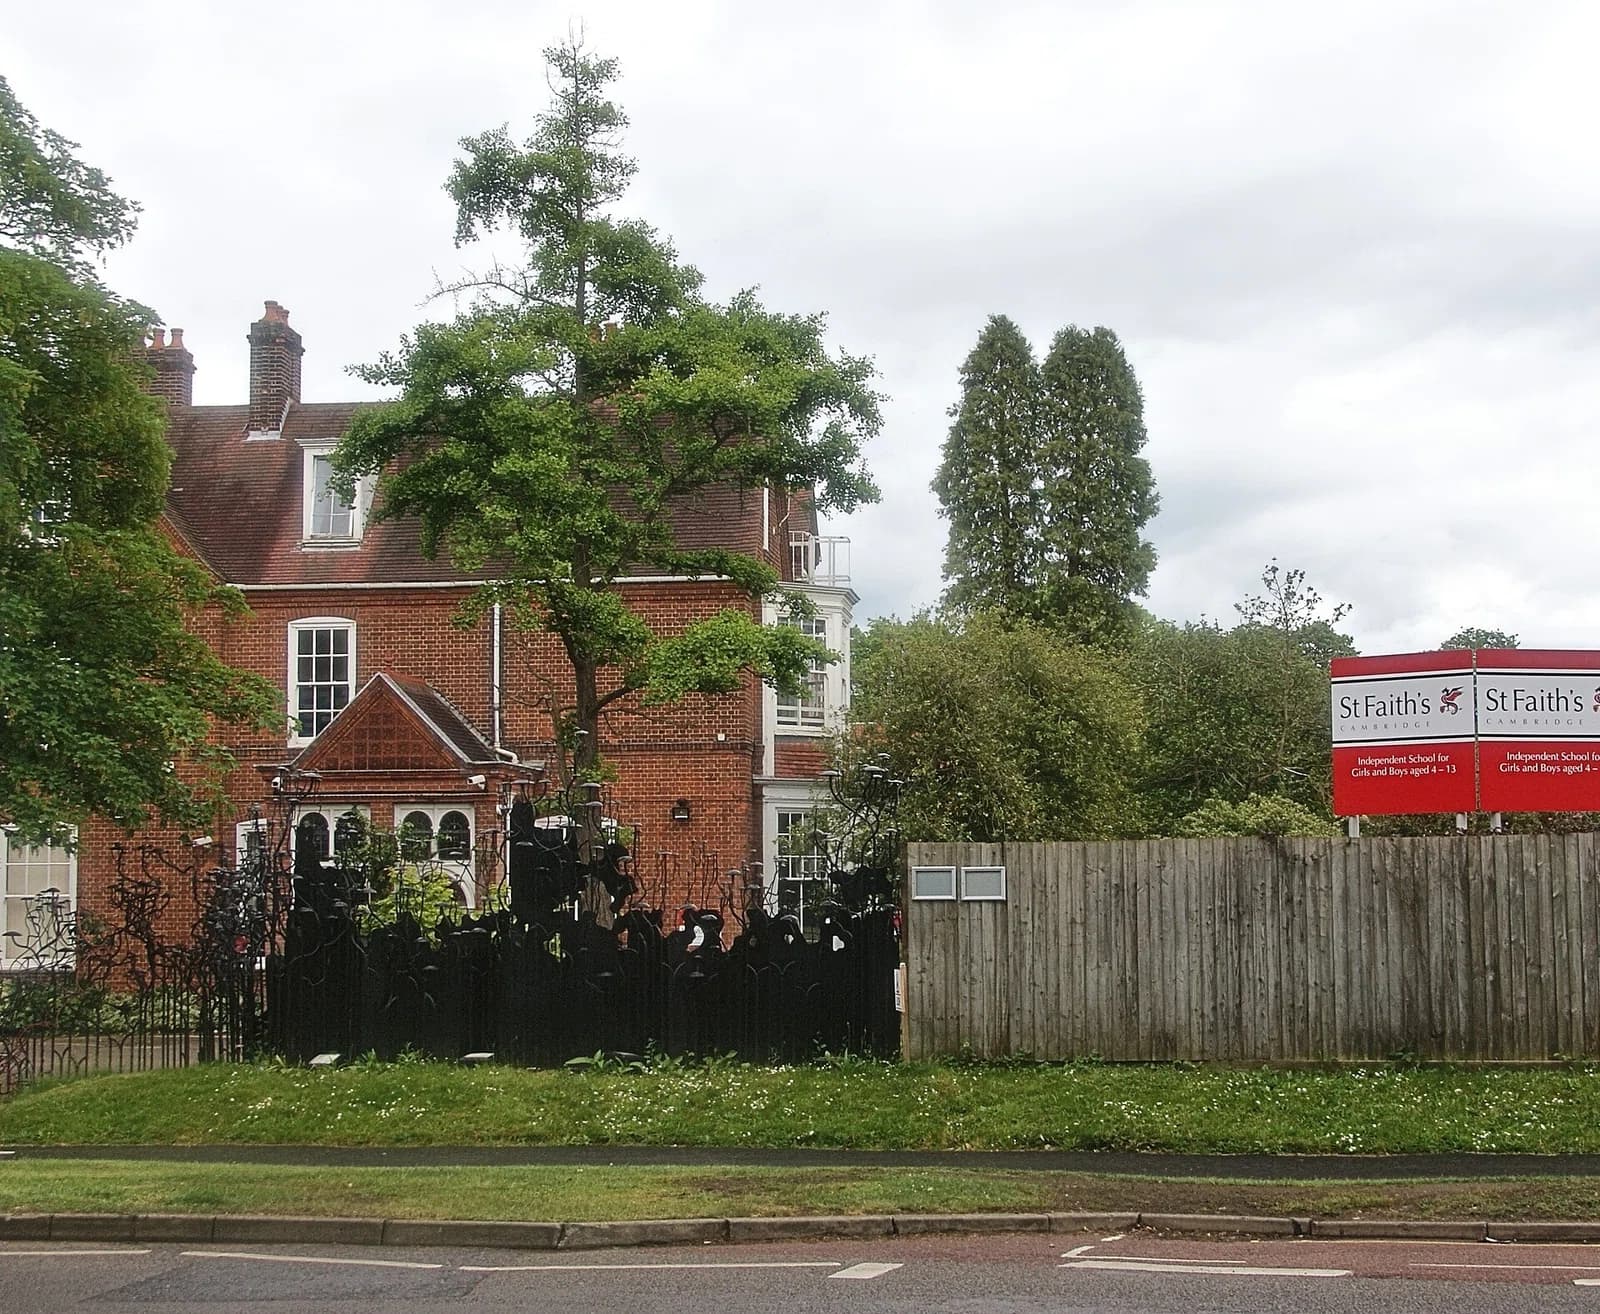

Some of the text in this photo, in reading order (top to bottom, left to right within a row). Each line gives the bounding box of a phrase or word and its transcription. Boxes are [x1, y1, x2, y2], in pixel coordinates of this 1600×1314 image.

[1340, 691, 1430, 718] St Faith's
[1486, 688, 1584, 712] St Faith's
[1340, 721, 1430, 731] CAMBRIDGE
[1358, 753, 1449, 766] Independent School for
[1507, 752, 1559, 761] Independent
[1561, 752, 1590, 761] School
[1352, 767, 1370, 778] Girls
[1372, 767, 1387, 776] and
[1389, 766, 1408, 778] Boys
[1410, 765, 1429, 776] aged
[1431, 765, 1437, 773] 4
[1446, 765, 1456, 773] 13
[1499, 763, 1519, 772] Girls
[1521, 763, 1537, 772] and
[1540, 763, 1560, 774] Boys
[1562, 763, 1582, 774] aged
[1585, 764, 1591, 772] 4
